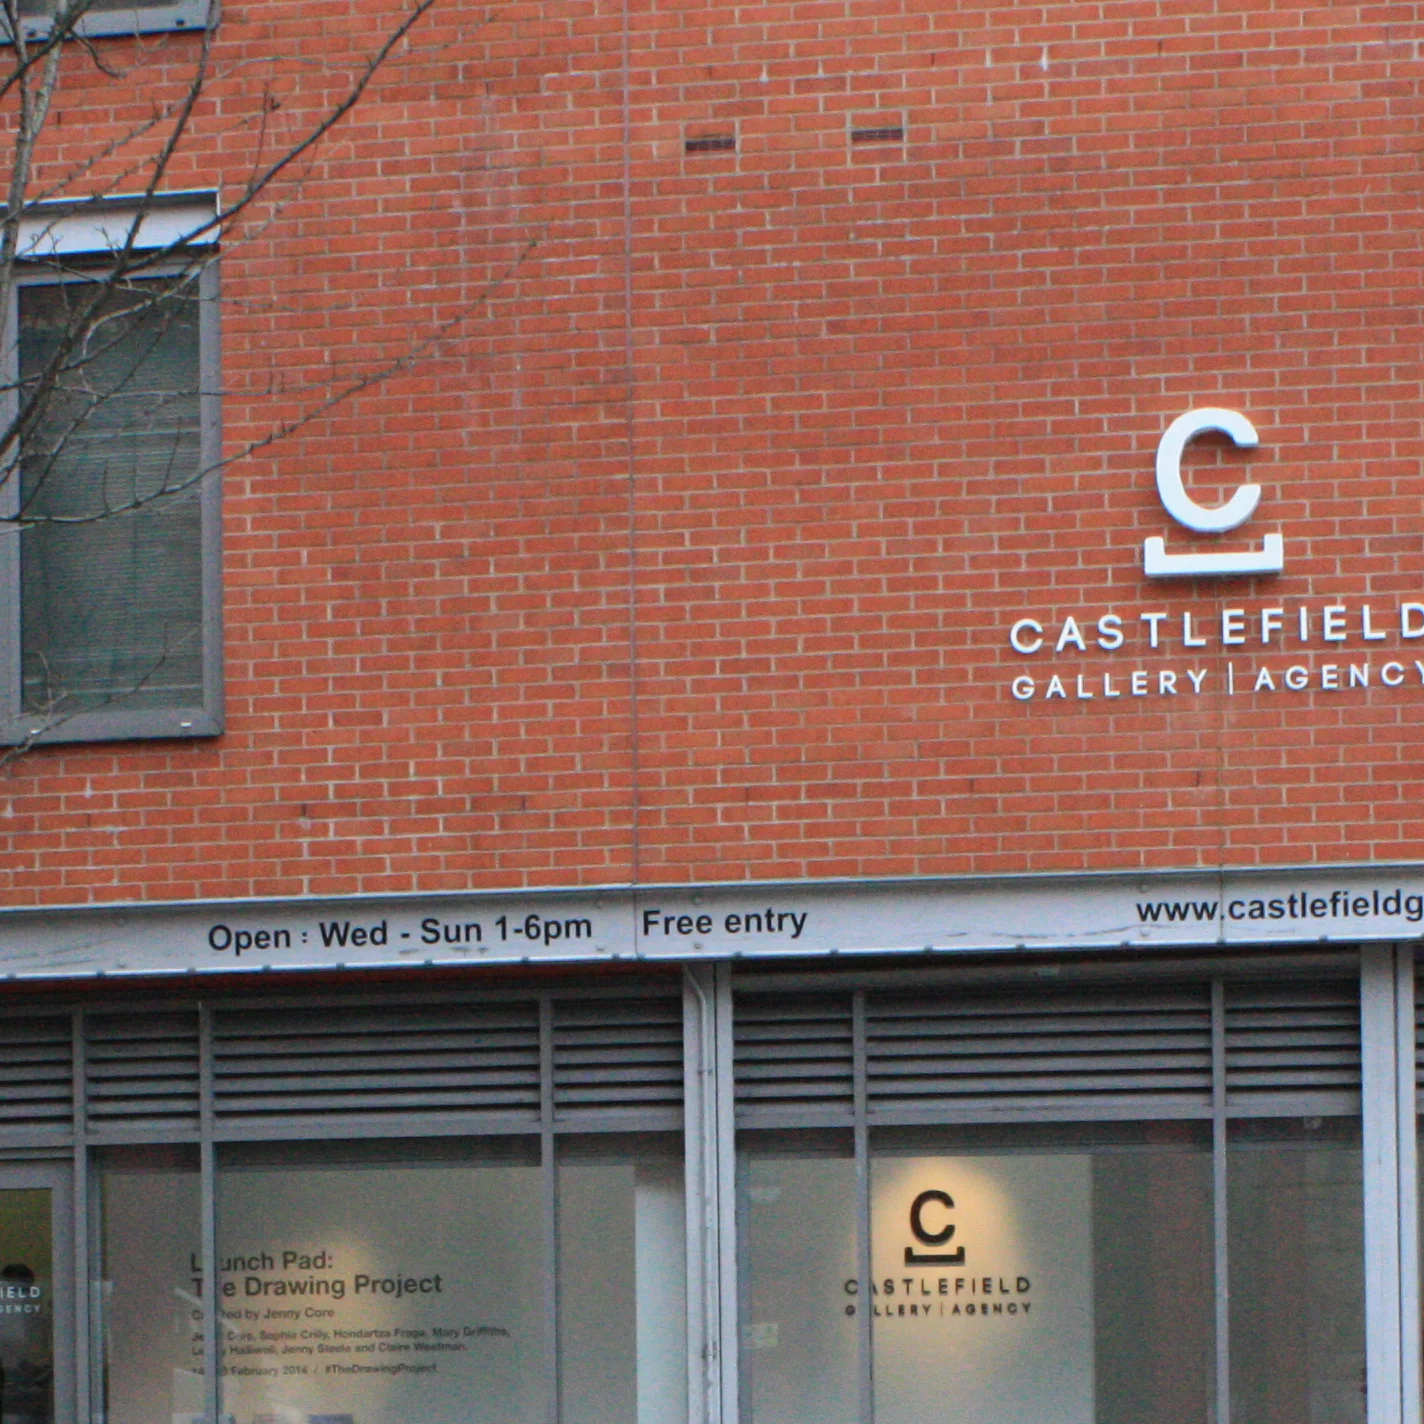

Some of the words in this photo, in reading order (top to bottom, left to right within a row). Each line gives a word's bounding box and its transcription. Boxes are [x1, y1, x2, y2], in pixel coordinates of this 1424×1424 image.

[1011, 668, 1208, 701] GALLERY
[207, 922, 292, 957] Open
[318, 917, 389, 948] Wed
[419, 915, 483, 946] Sun
[494, 913, 594, 947] 1-6pm
[641, 907, 714, 937] Free
[723, 908, 809, 940] entry
[190, 1251, 274, 1273] Lunch
[282, 1250, 333, 1271] Pad:
[191, 1276, 236, 1298] Te
[244, 1275, 345, 1300] Drawing
[354, 1273, 443, 1299] Project
[245, 1308, 260, 1321] by
[263, 1307, 301, 1320] Jenny
[304, 1306, 336, 1319] Core
[844, 1303, 932, 1317] GLLERY
[951, 1301, 1032, 1316] AGENCY
[355, 1341, 375, 1353] and
